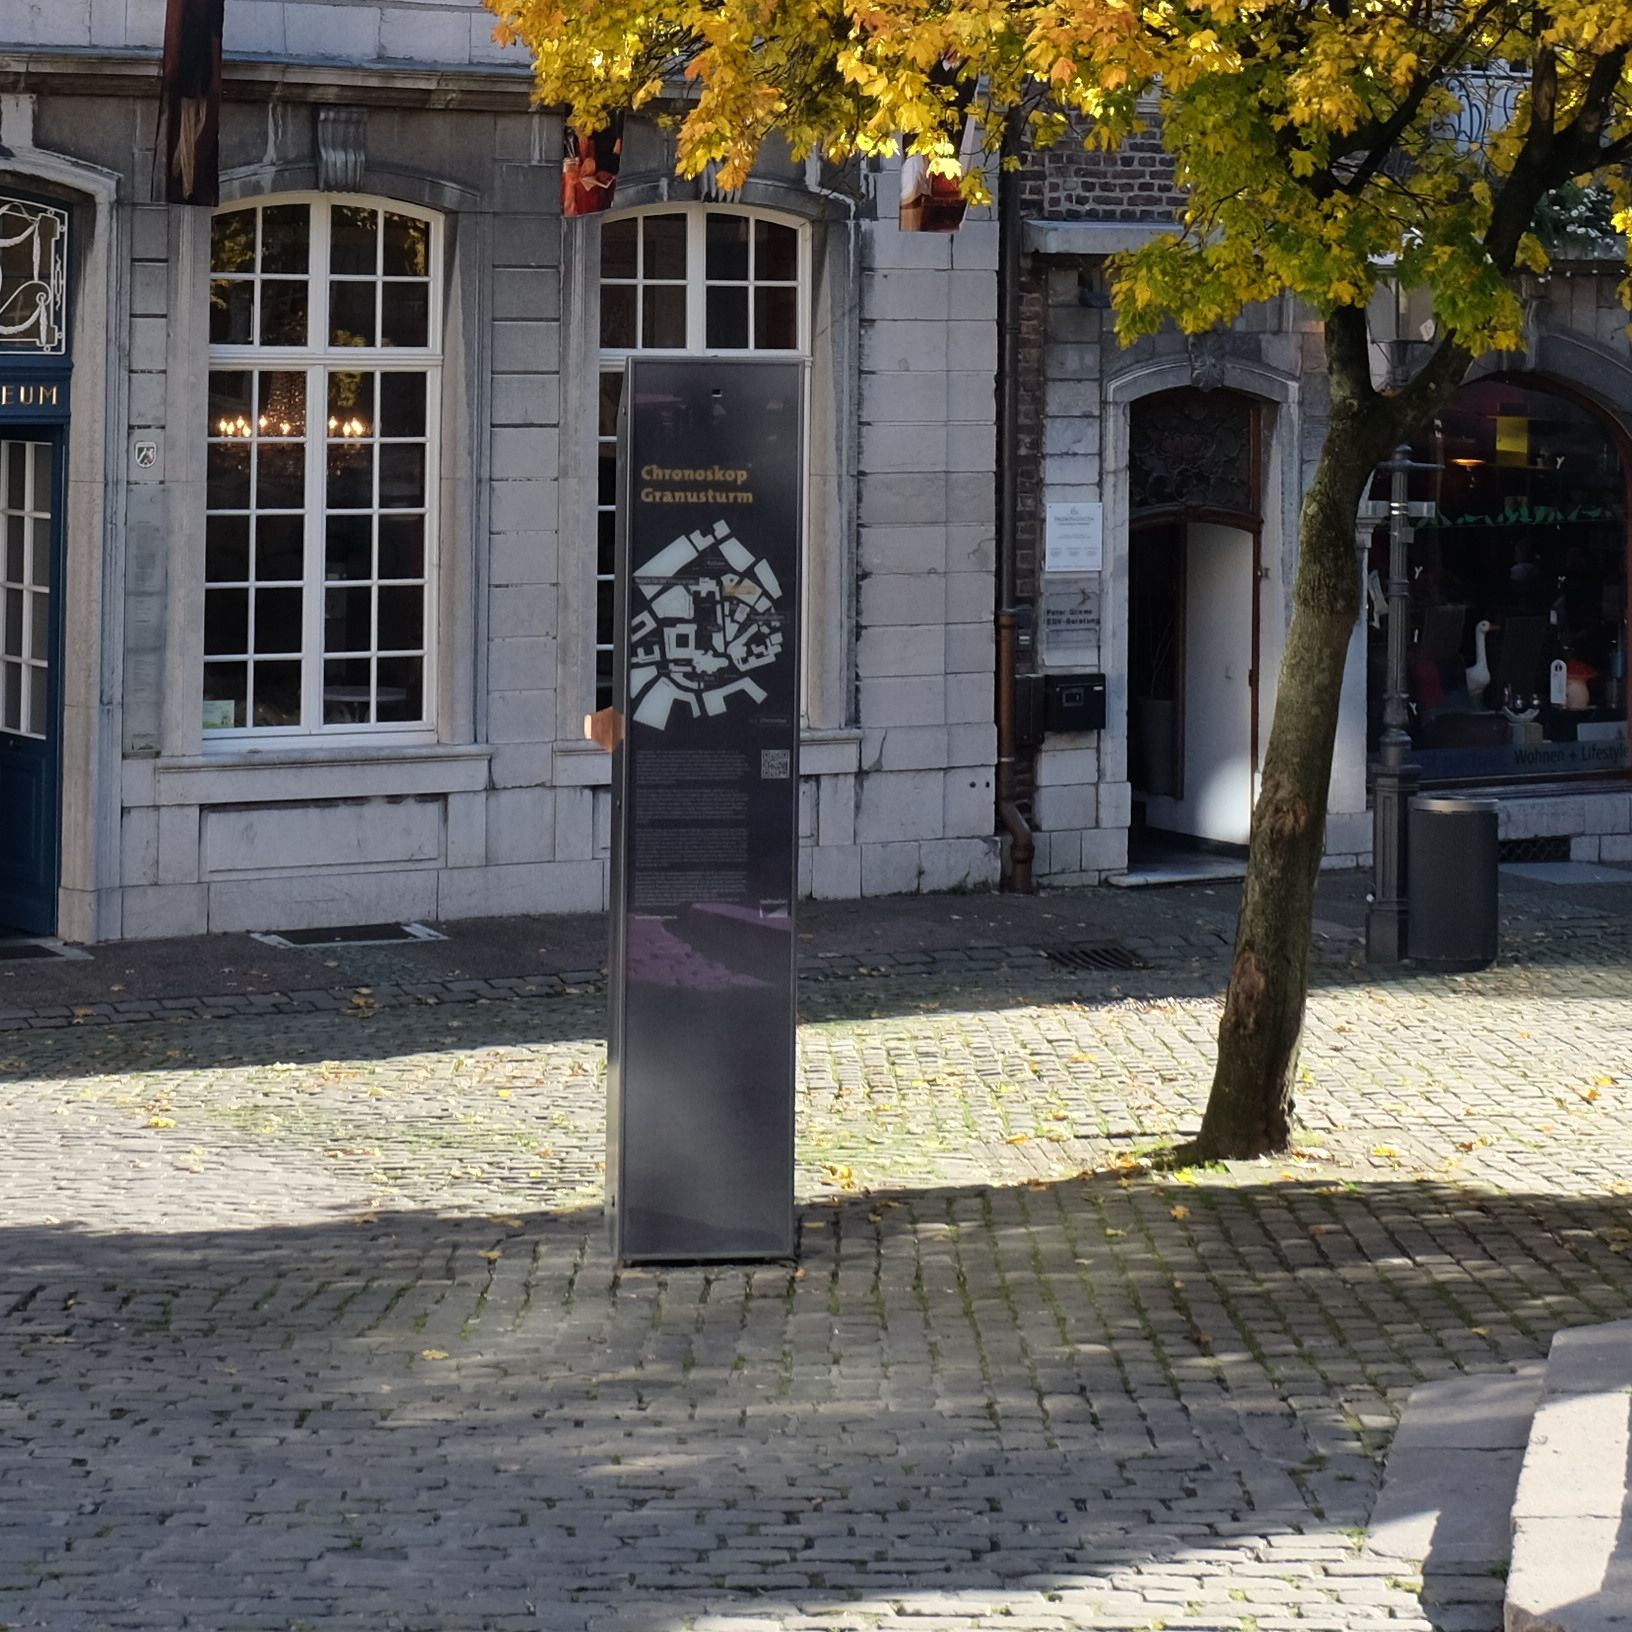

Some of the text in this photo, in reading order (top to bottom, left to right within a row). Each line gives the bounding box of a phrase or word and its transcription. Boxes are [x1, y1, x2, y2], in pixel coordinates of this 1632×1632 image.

[640, 464, 748, 485] Chronoskop
[640, 488, 753, 503] Granusturm
[1513, 749, 1565, 765] Wohnen
[1581, 742, 1629, 763] Lifestyle
